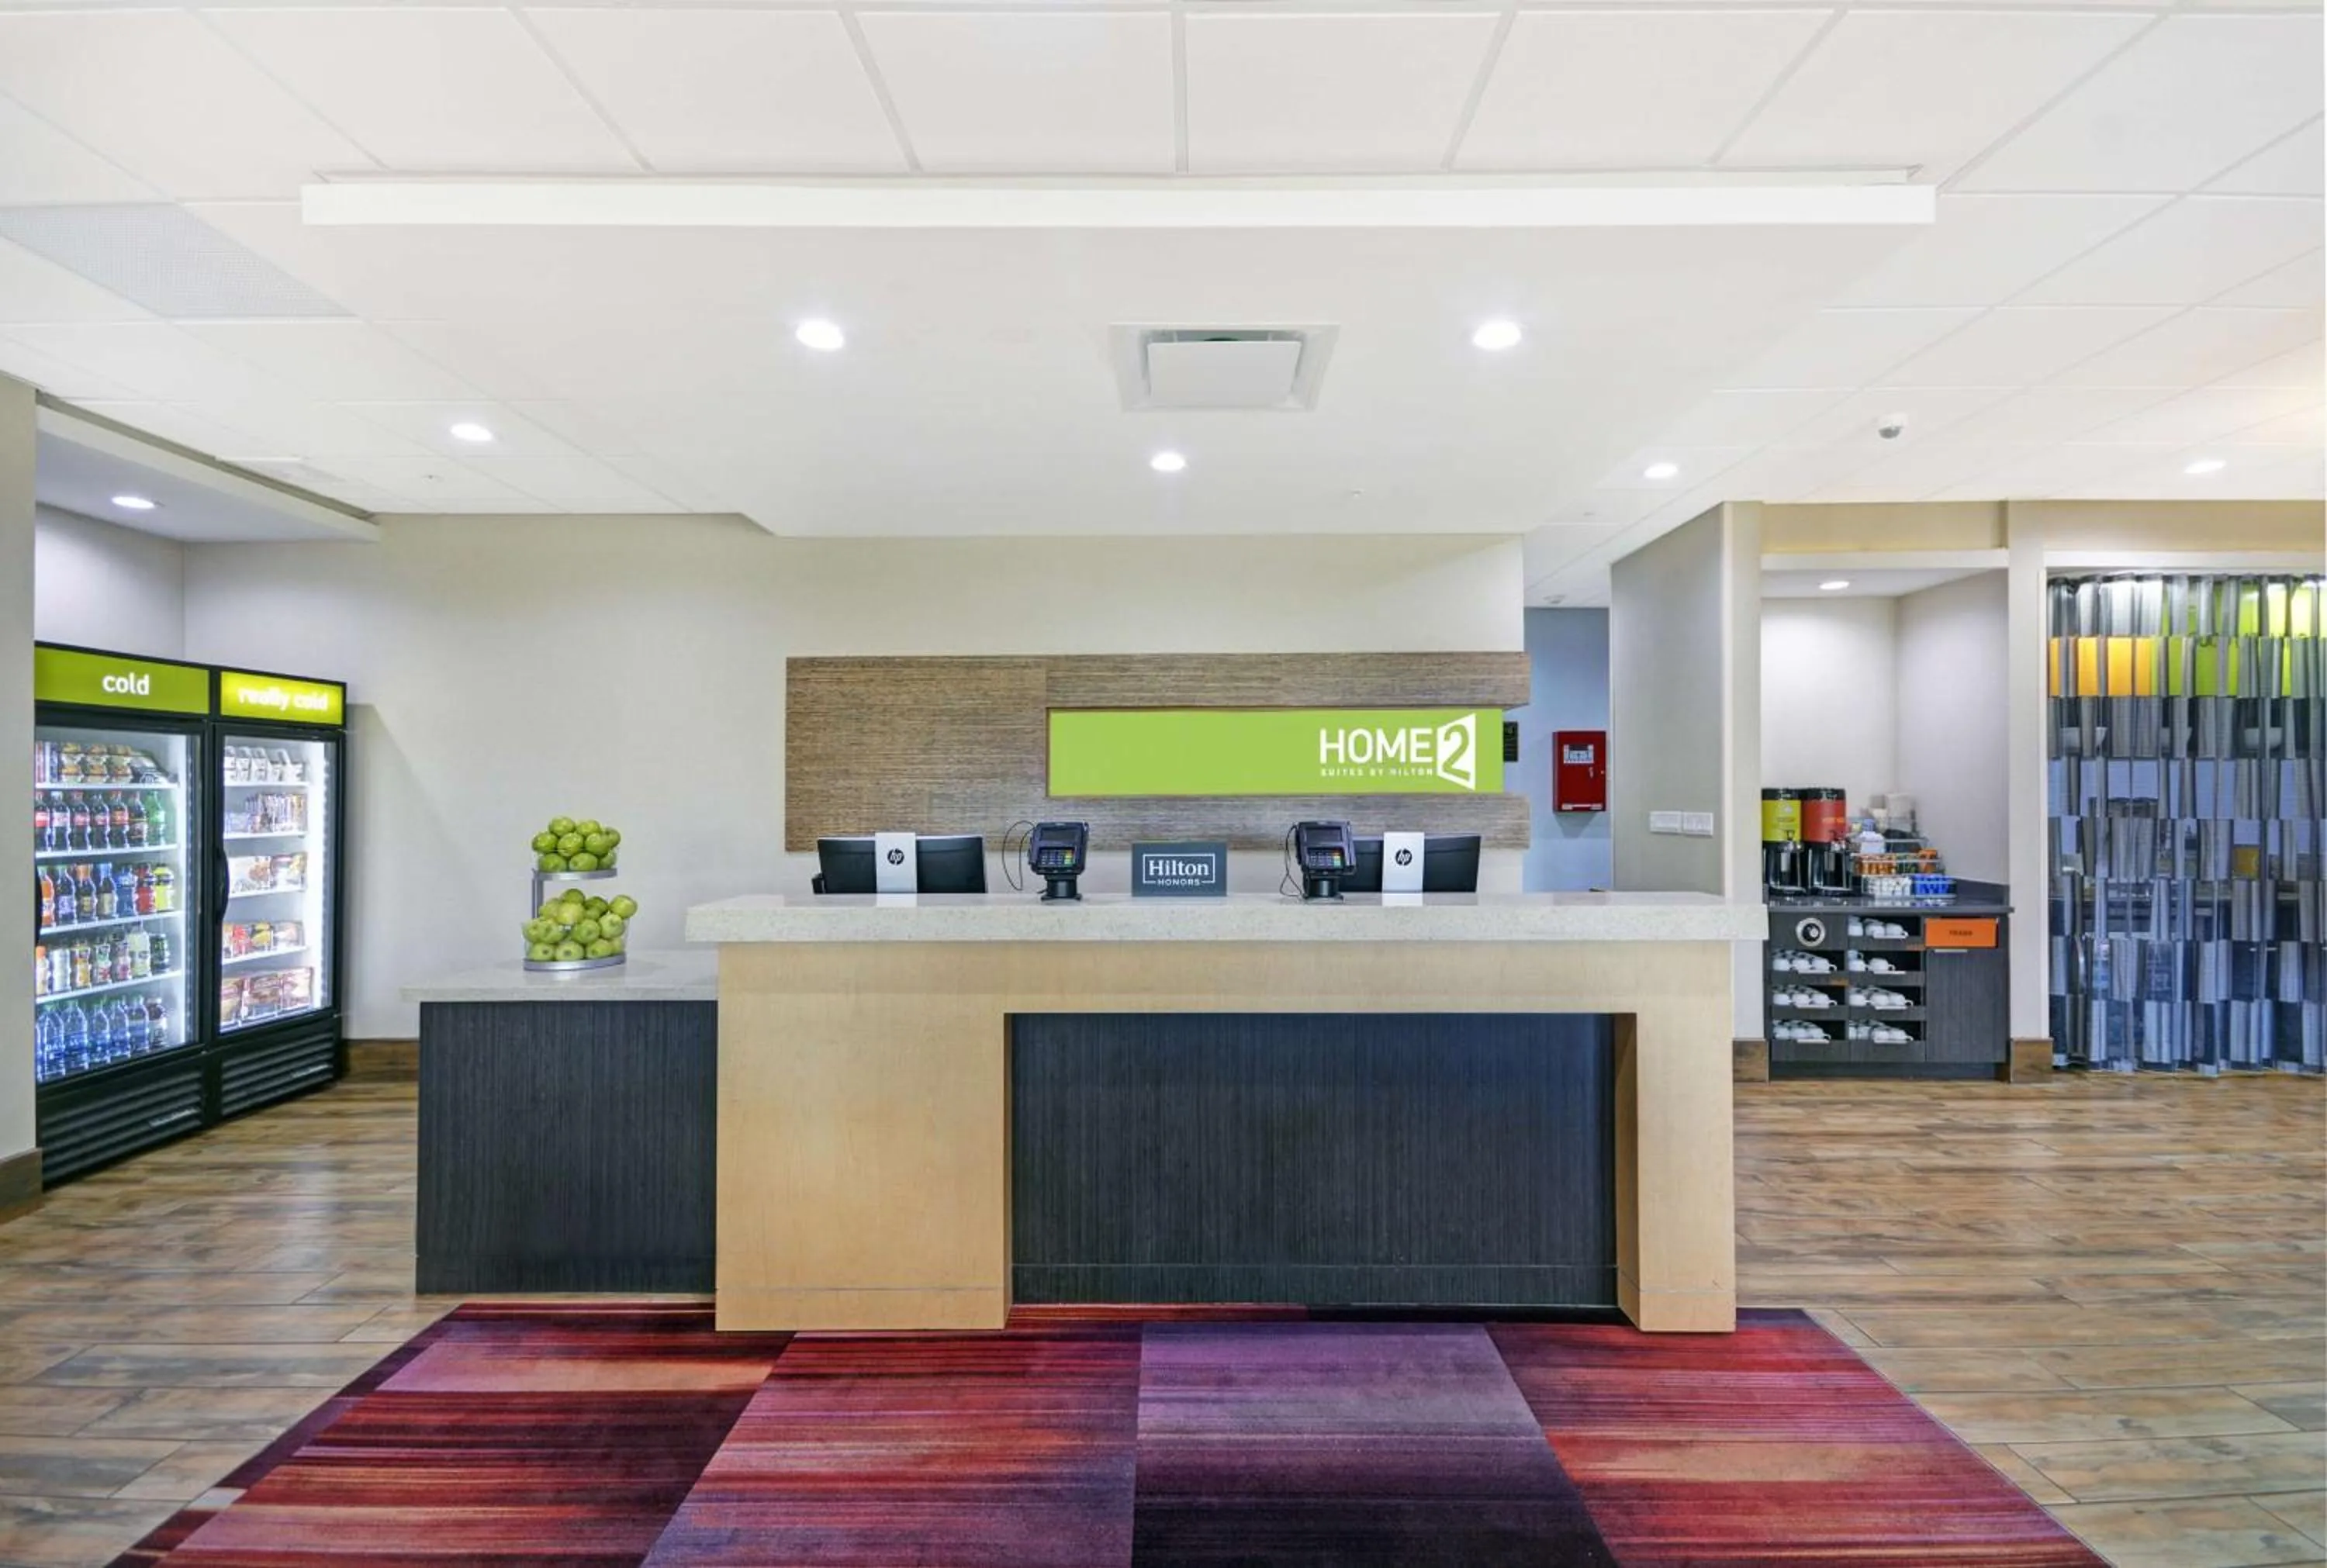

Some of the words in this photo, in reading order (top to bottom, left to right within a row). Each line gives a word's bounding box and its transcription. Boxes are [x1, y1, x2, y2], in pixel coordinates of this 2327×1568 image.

[102, 672, 150, 695] cold
[237, 686, 290, 711] really
[294, 691, 328, 711] cold
[1370, 768, 1385, 776] BY
[1390, 768, 1433, 776] HILTON
[1149, 859, 1209, 876] Hilton
